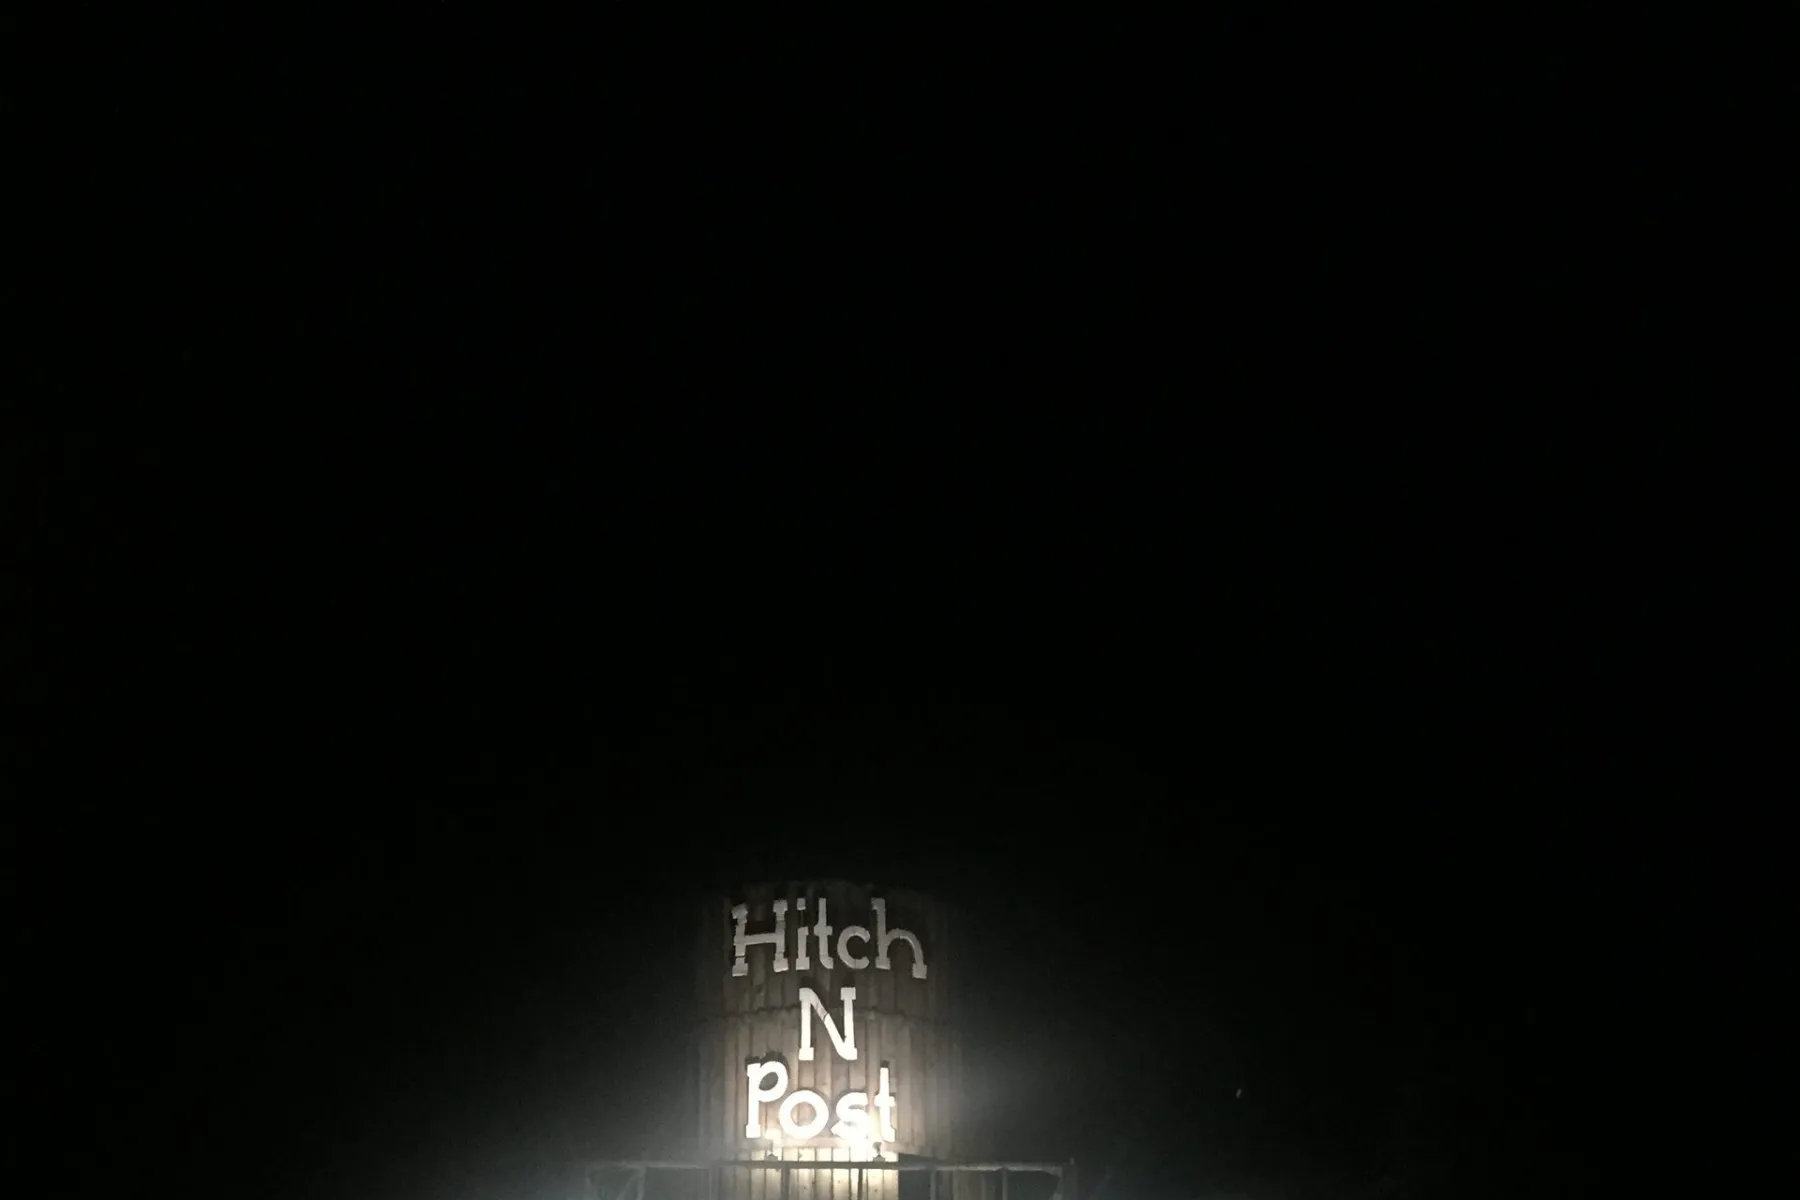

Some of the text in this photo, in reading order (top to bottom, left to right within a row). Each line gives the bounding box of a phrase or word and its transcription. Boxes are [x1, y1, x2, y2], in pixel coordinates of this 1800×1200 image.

[731, 897, 927, 979] Hitch
[798, 987, 858, 1061] N
[746, 1060, 897, 1141] Post
